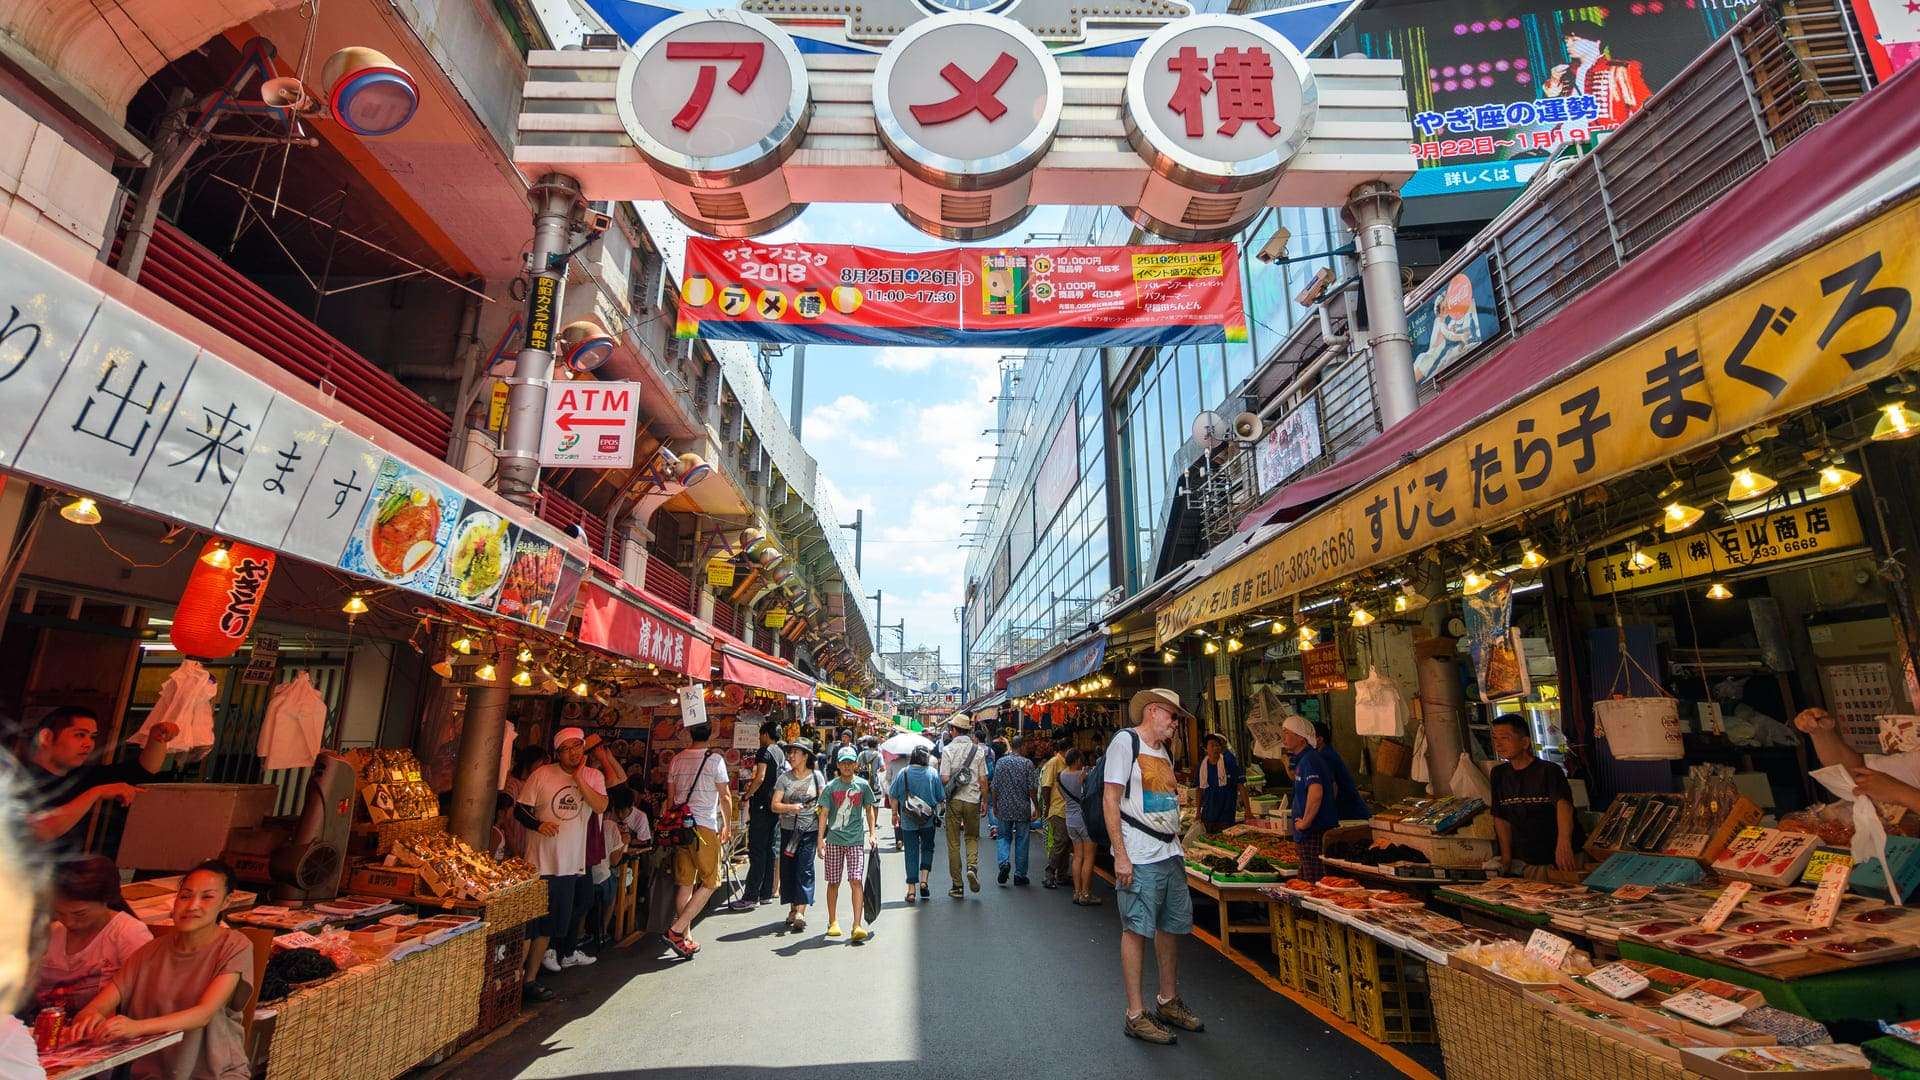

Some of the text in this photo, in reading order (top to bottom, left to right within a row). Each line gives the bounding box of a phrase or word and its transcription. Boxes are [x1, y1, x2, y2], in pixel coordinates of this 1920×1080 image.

[666, 42, 1281, 139] アメ横
[1414, 95, 1599, 135] やぎ座の運勢
[1444, 168, 1510, 187] 詳しくは
[722, 246, 829, 267] サマーフェスタ
[739, 262, 807, 283] 2018
[530, 277, 553, 349] 防犯カメラ作動中
[723, 291, 822, 316] アメ横
[1641, 250, 1912, 439] まぐろ
[557, 389, 629, 412] ATM
[600, 438, 619, 446] EPOS
[1470, 386, 1612, 509] たら子
[1364, 466, 1457, 554] すじこ
[1784, 536, 1818, 553] 6668
[219, 557, 271, 639] やきとり
